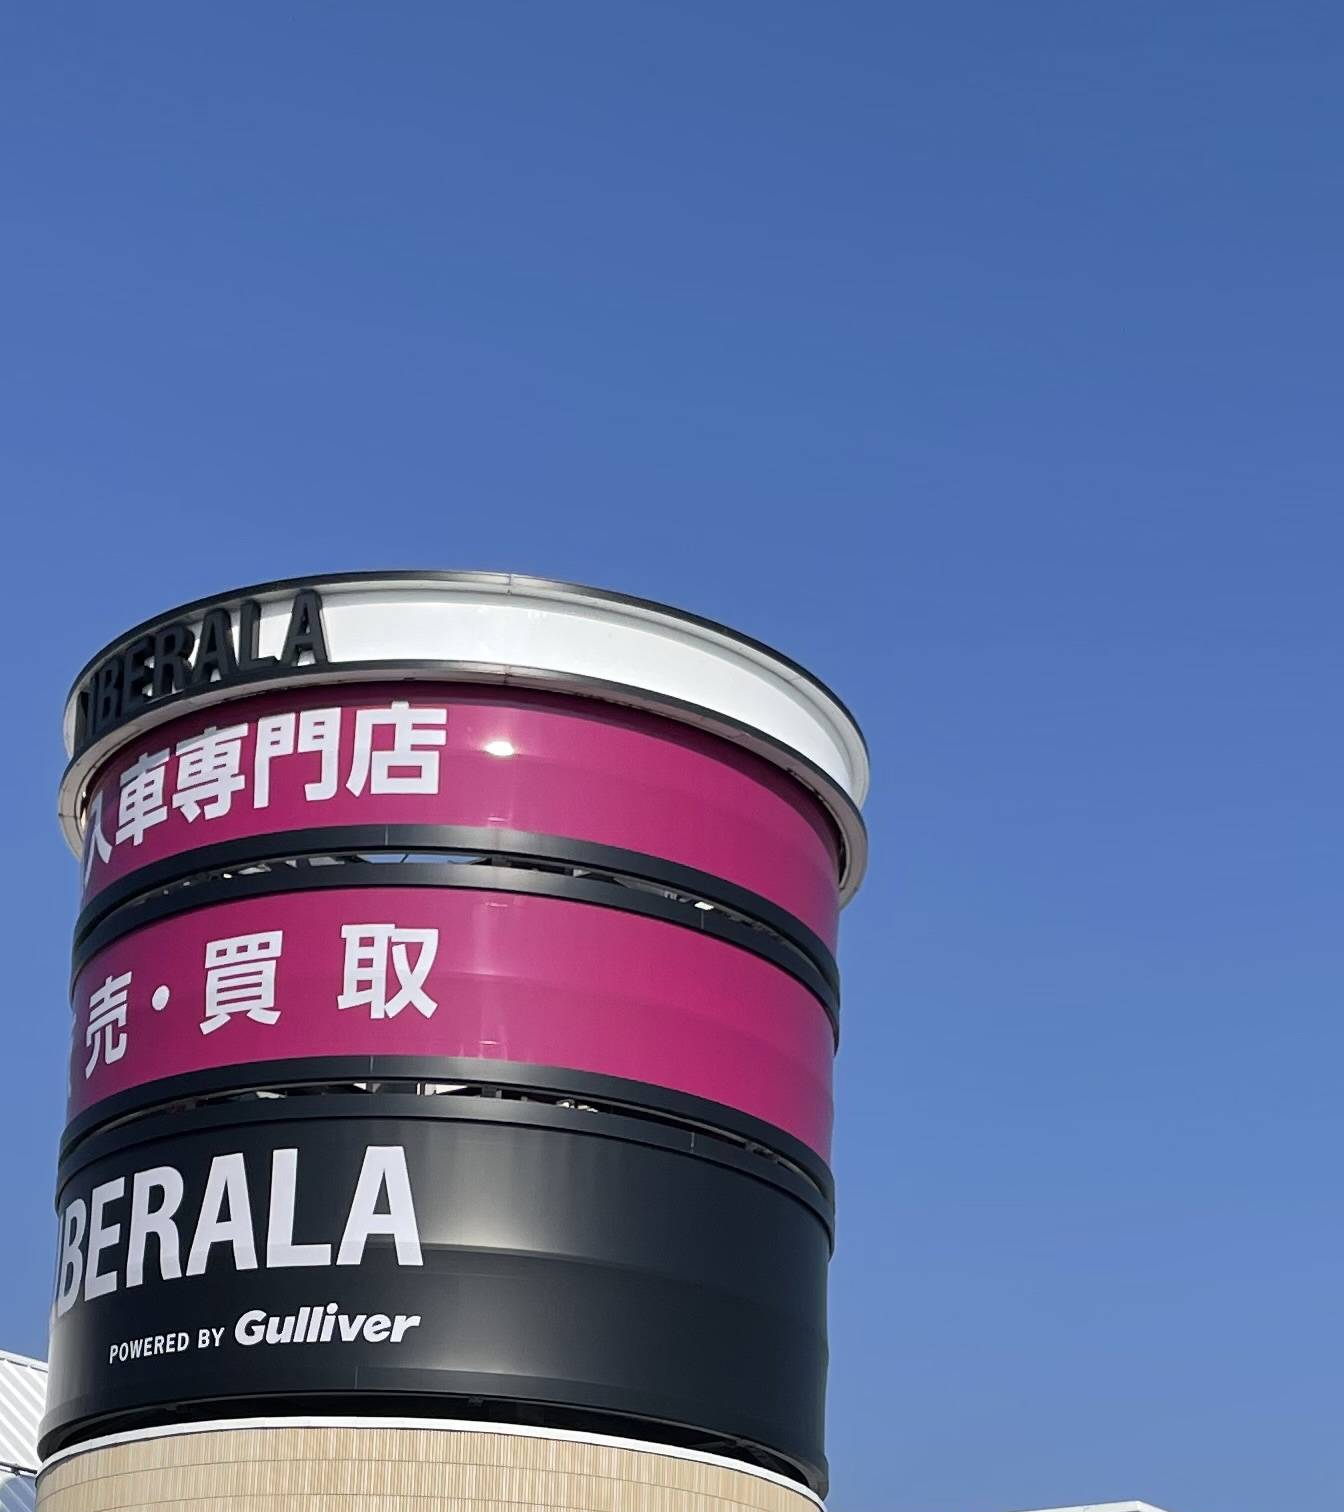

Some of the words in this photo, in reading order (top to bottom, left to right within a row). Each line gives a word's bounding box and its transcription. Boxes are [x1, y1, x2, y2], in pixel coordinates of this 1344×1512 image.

[109, 1332, 189, 1364] POWERED
[197, 1327, 225, 1350] BY
[234, 1302, 421, 1346] Gulliver
